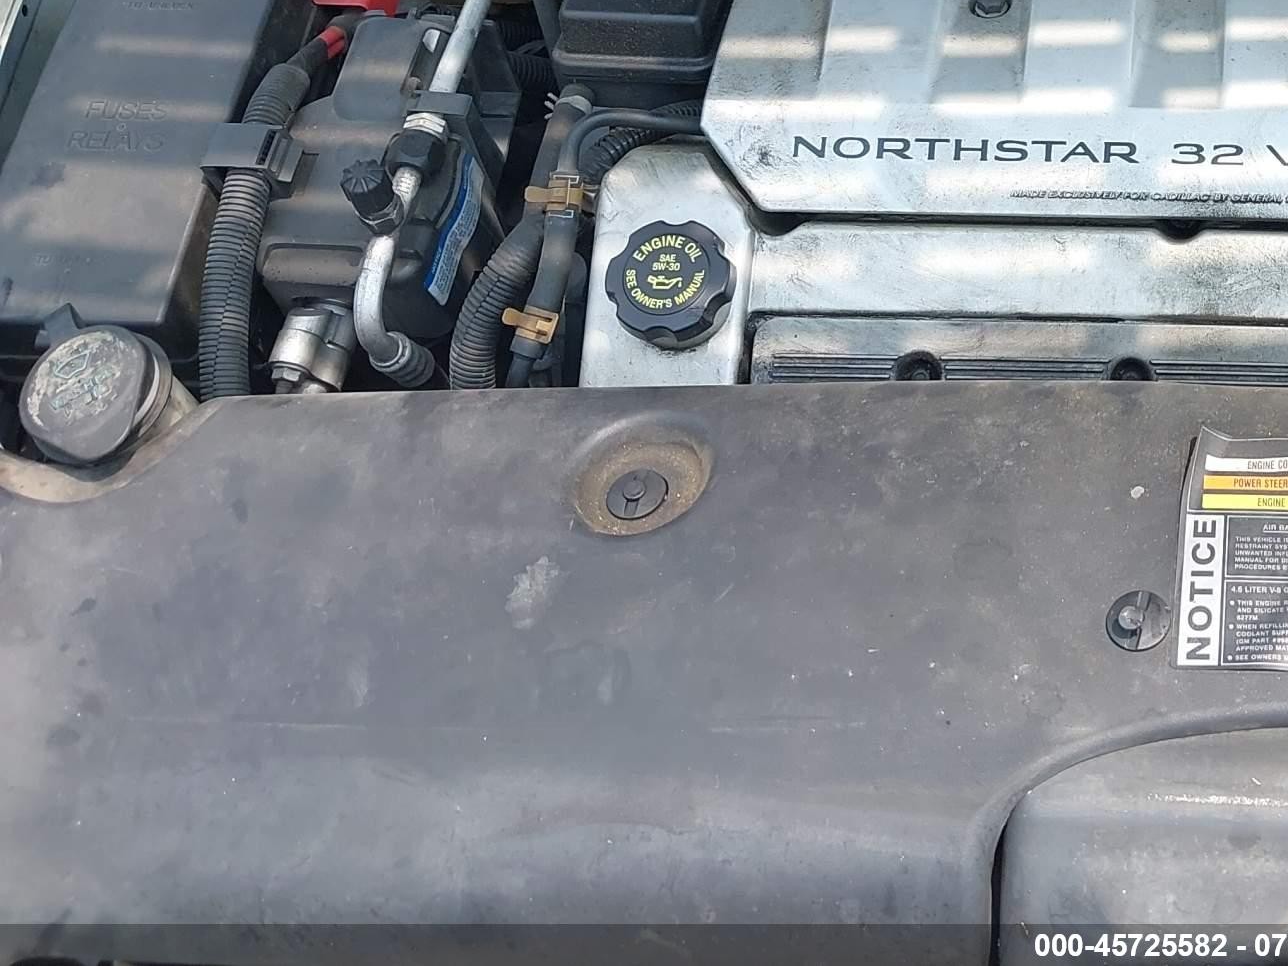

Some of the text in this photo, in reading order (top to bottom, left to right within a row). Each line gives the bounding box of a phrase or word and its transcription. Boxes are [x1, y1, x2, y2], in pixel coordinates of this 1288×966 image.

[85, 99, 167, 121] FUSES
[66, 130, 165, 152] RELAYS
[792, 136, 1140, 164] NORTHSTAR
[1171, 143, 1244, 165] 32
[1010, 190, 1047, 199] MADE
[1123, 192, 1150, 201] FOR
[1151, 192, 1211, 202] CADILLAC
[1213, 193, 1229, 203] BY
[1231, 194, 1282, 205] GENERAL
[632, 234, 702, 263] ENGINE OIL
[659, 254, 677, 262] SAE
[652, 262, 680, 271] 5W-30
[625, 269, 705, 309] SEE OWNER'S MANUAL
[1247, 460, 1275, 470] ENGINE
[1233, 478, 1263, 488] POWER
[1257, 497, 1285, 508] ENGINE
[1235, 563, 1281, 571] PROCEDURES
[1186, 520, 1217, 660] NOTICE
[1231, 585, 1243, 593] 4.6
[1269, 586, 1282, 594] V-8
